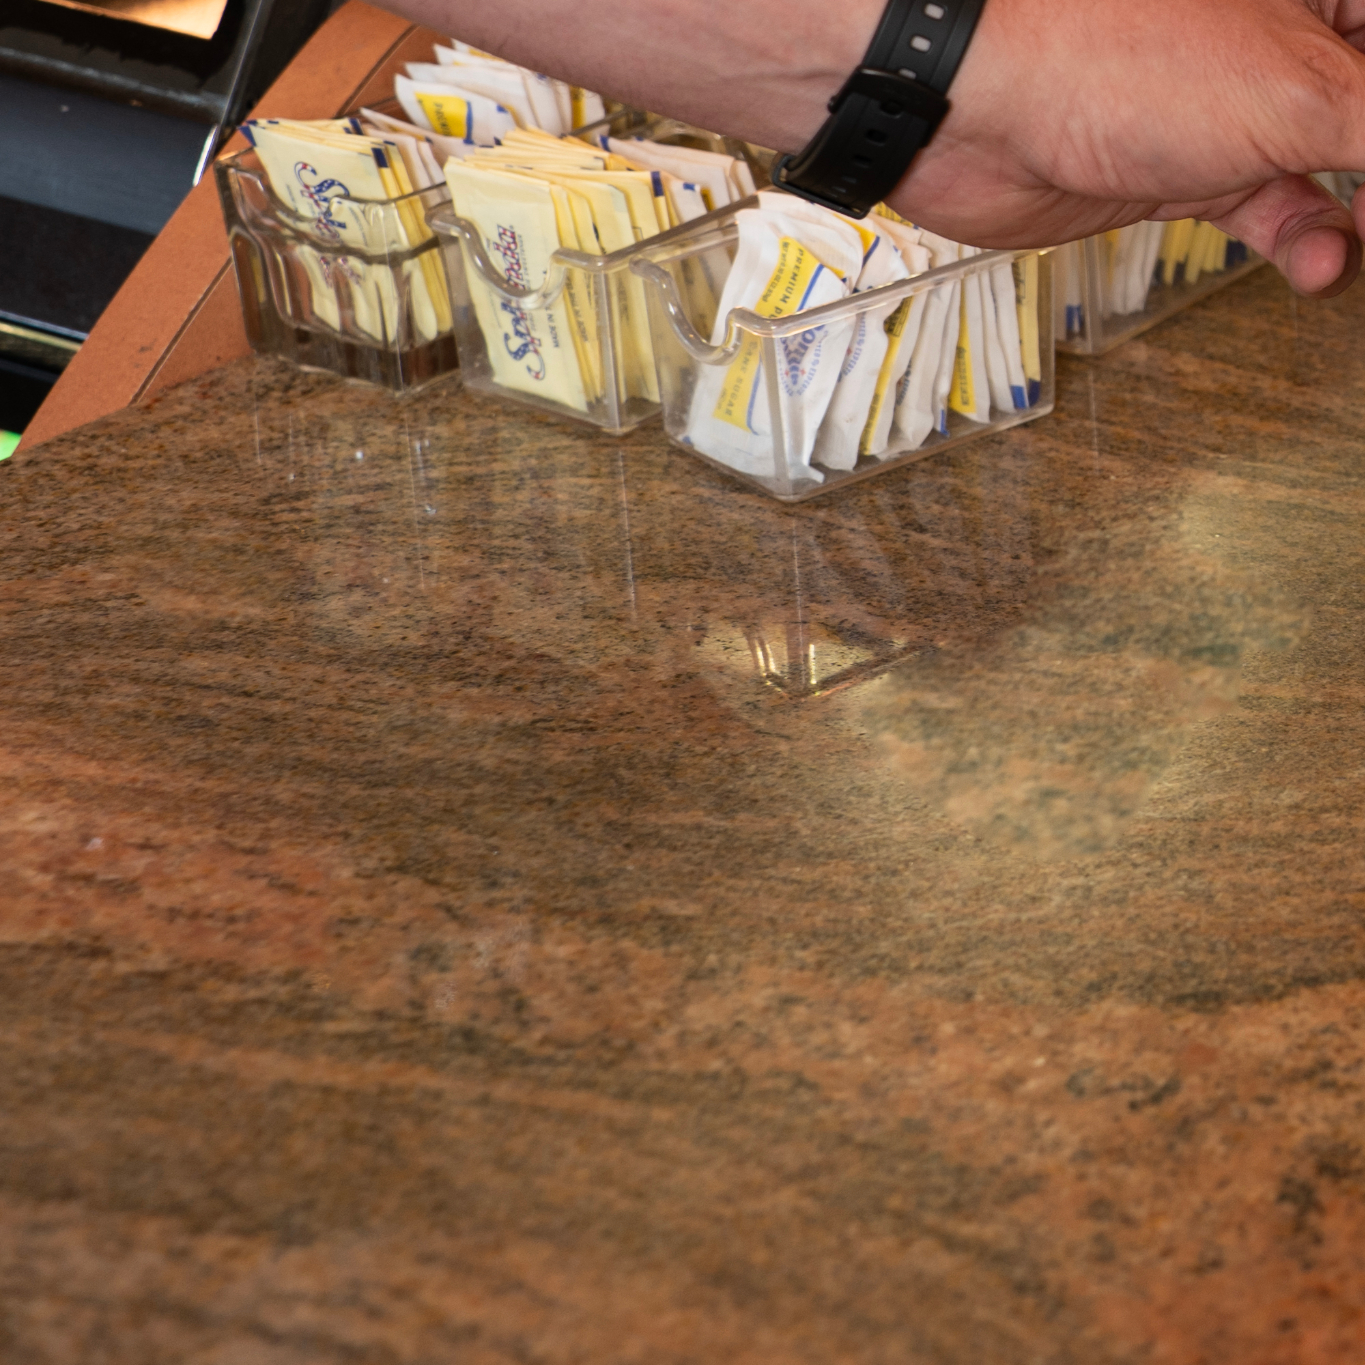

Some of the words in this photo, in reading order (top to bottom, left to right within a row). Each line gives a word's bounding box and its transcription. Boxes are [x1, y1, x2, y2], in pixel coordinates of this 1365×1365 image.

[494, 224, 546, 381] Splnda
[781, 248, 804, 303] PREMIUM
[724, 377, 743, 417] SUGAR
